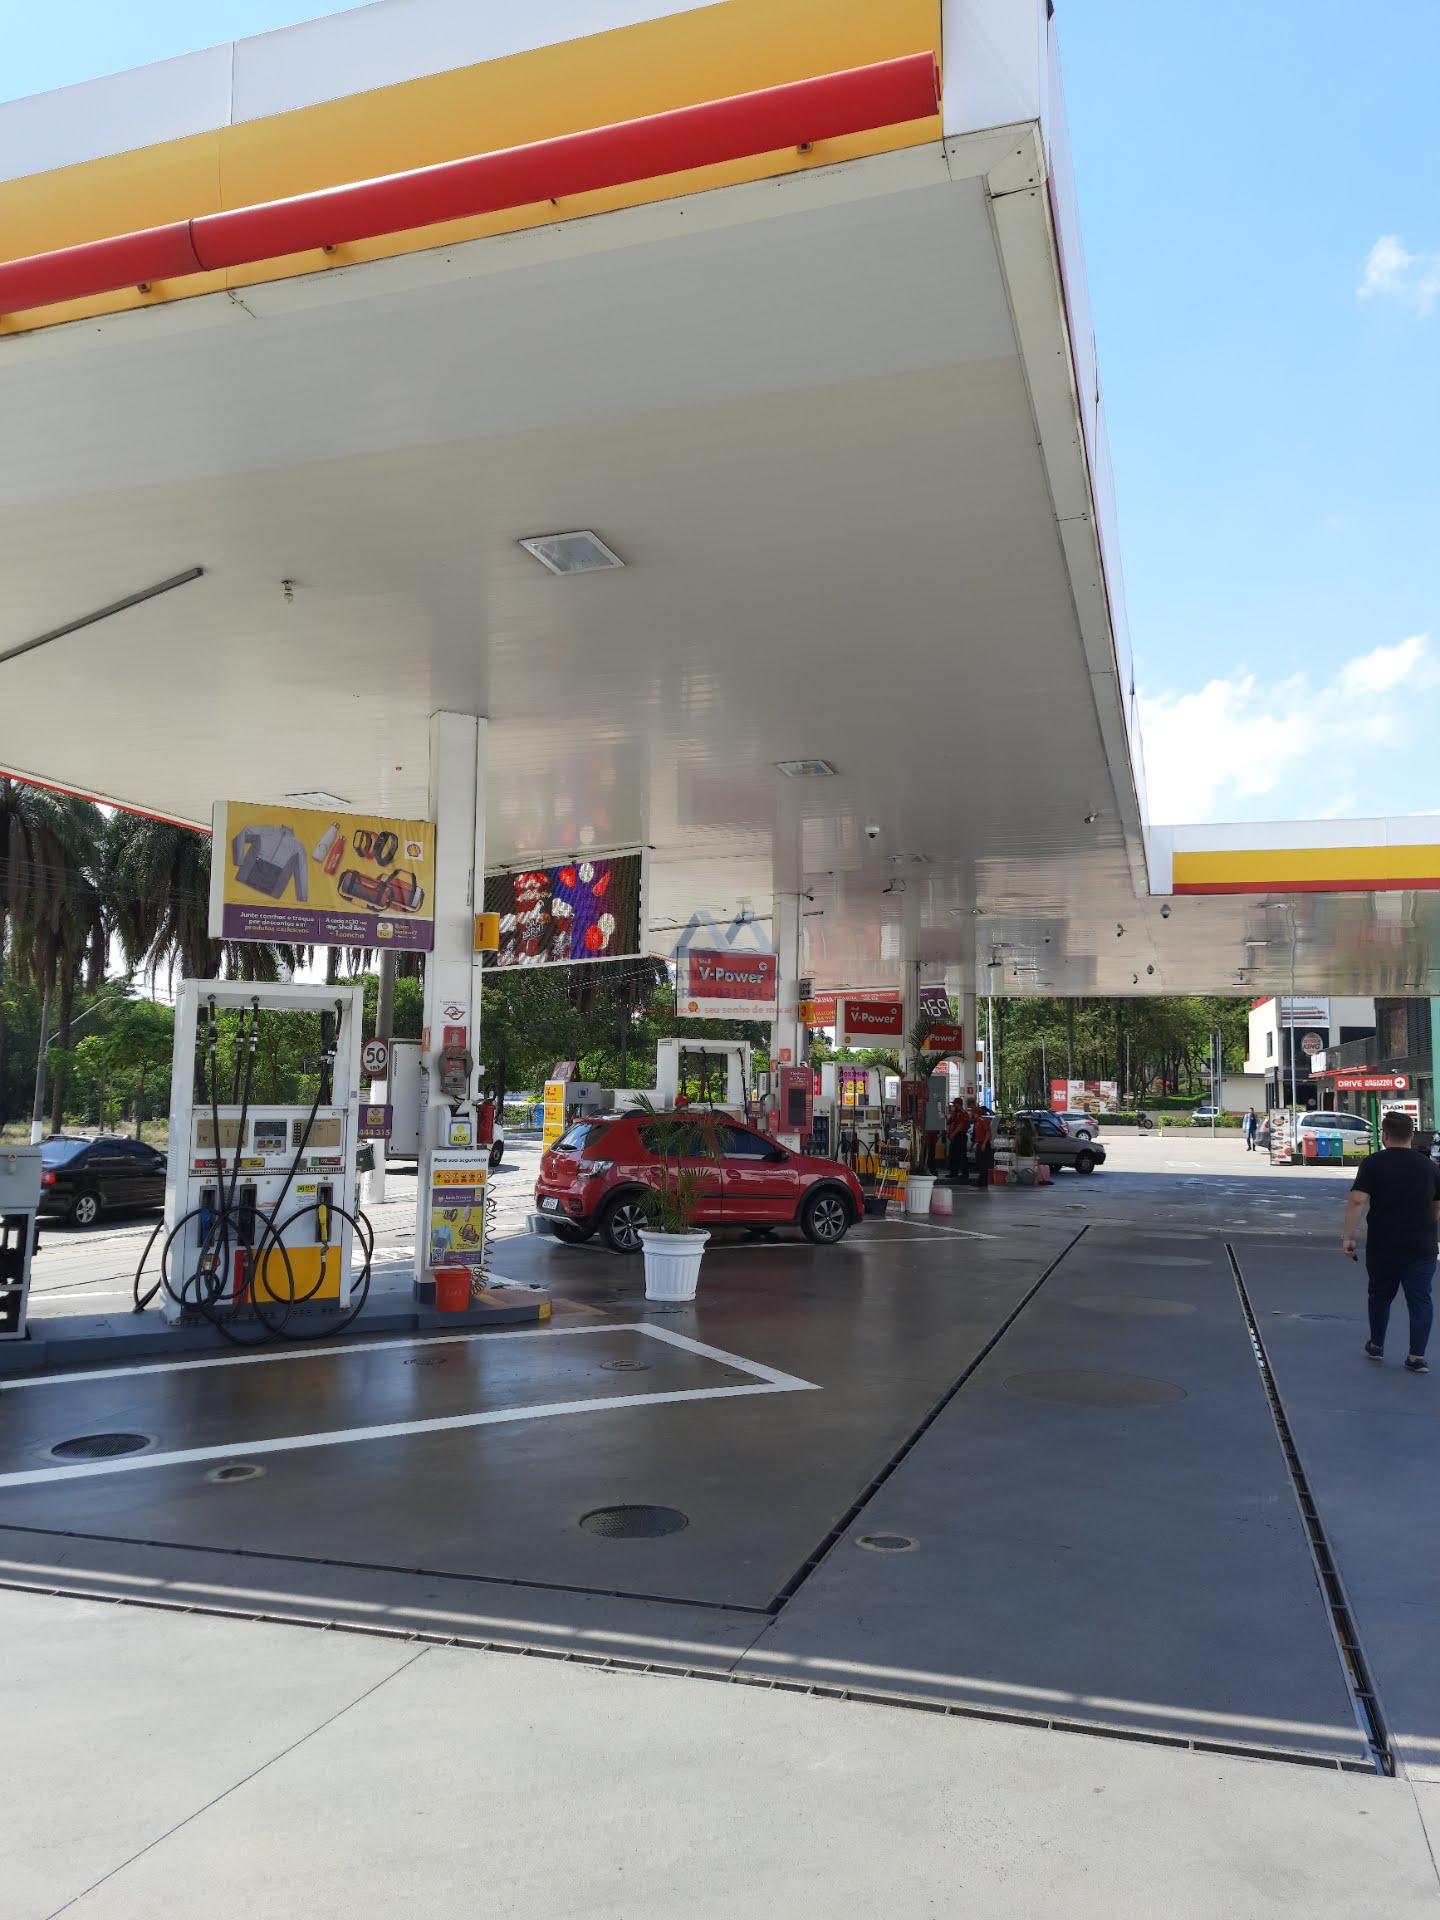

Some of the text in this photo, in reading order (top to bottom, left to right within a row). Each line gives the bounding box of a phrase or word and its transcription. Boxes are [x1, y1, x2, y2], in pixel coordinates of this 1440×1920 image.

[264, 919, 295, 927] descontos
[292, 915, 315, 923] troque
[244, 924, 309, 934] produtos exclusivos
[338, 923, 354, 931] Shell
[699, 967, 764, 985] V-Power
[801, 1006, 807, 1017] 3
[850, 1012, 896, 1024] V-Power
[366, 1047, 386, 1064] 50
[360, 1128, 375, 1136] 444
